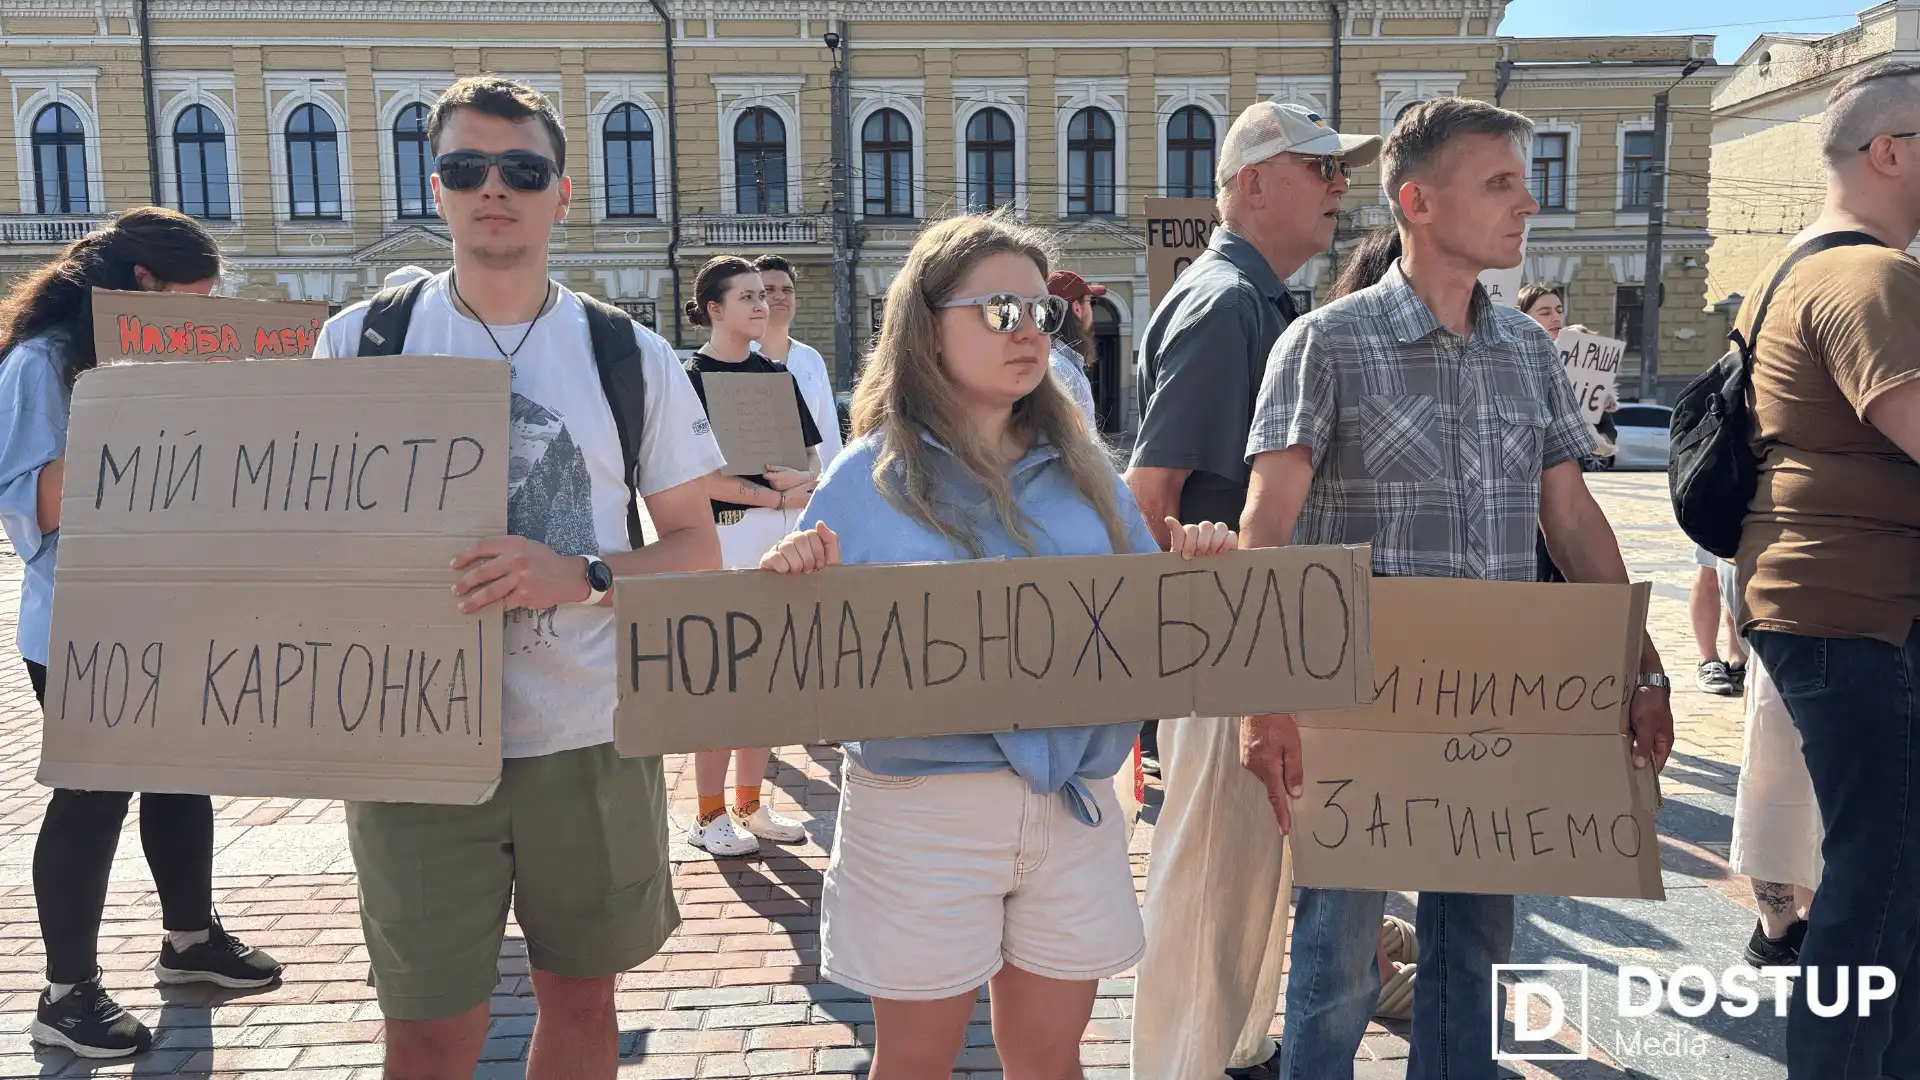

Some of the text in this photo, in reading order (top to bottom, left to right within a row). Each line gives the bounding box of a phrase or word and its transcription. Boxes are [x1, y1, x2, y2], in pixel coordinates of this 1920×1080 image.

[1581, 342, 1621, 373] РАША
[95, 429, 484, 512] МІЙ МІНІСТР
[1157, 563, 1350, 679] БУЛО
[60, 619, 484, 746] МОЯ КАРТОНКА!
[1444, 728, 1513, 762] або
[1312, 779, 1641, 861] ЗАГИНЕМО
